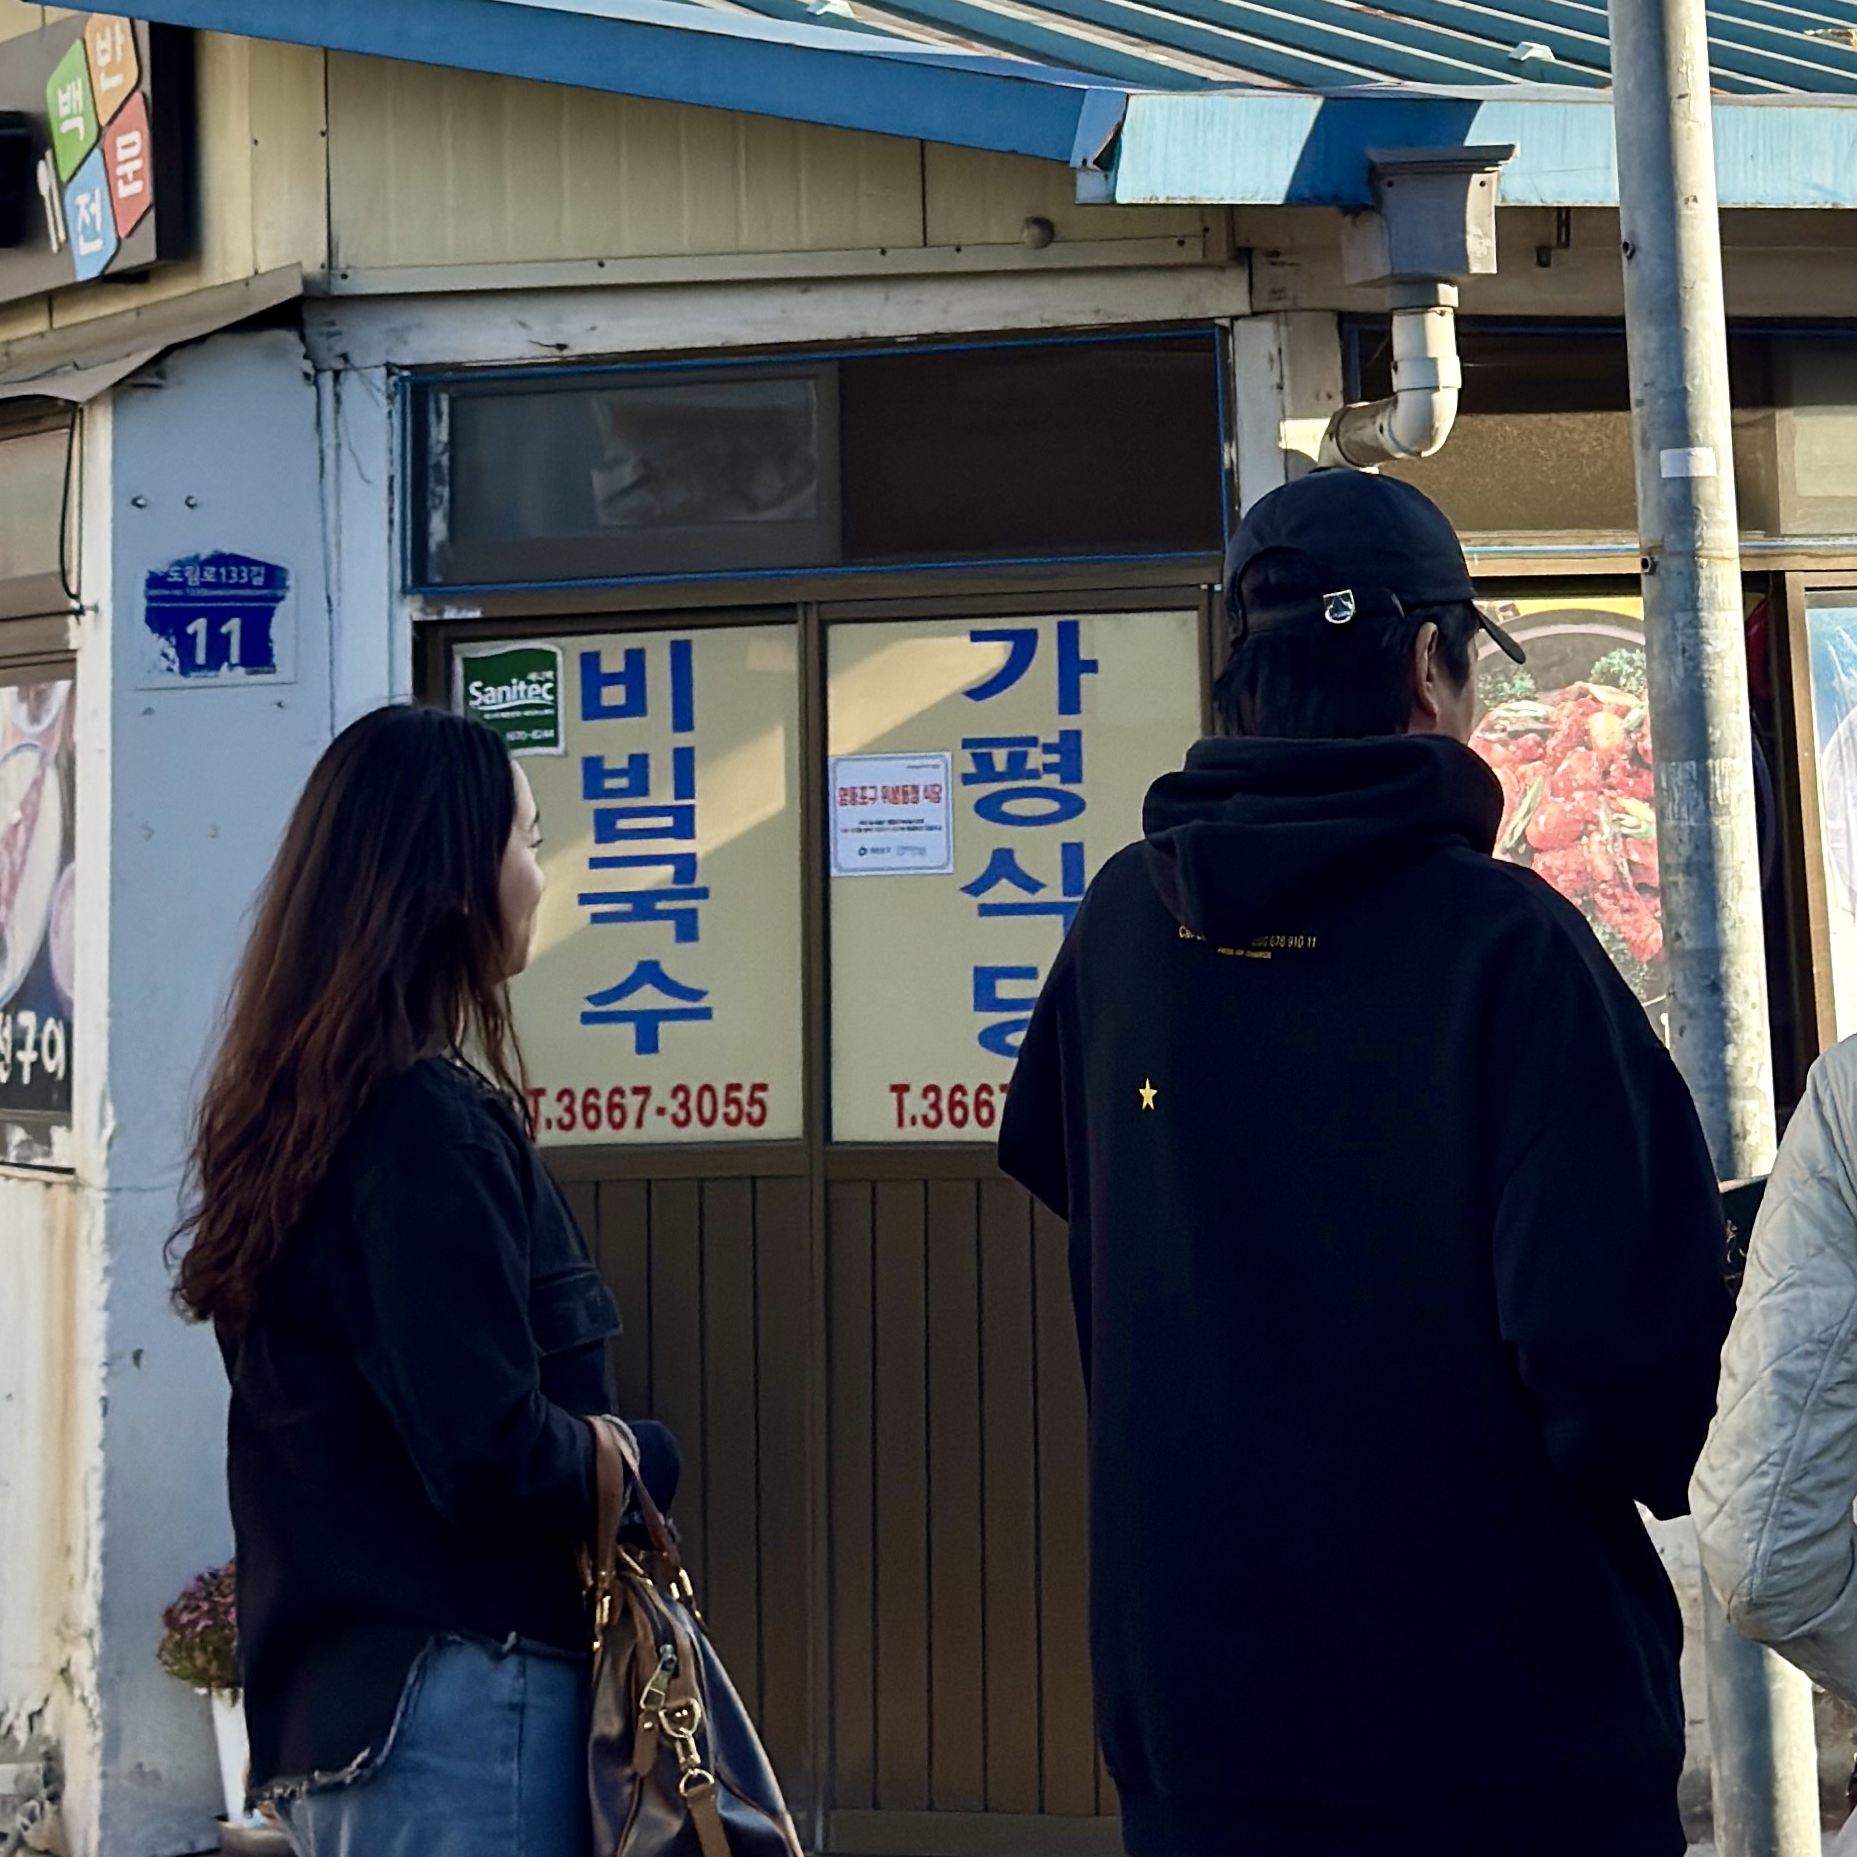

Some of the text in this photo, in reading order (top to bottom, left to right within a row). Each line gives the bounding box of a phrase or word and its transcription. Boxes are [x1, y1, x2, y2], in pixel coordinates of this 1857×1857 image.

[186, 617, 241, 665] 11
[468, 678, 554, 709] Sanitec
[578, 638, 713, 1056] 비빔국수
[527, 1083, 769, 1132] T.3667-3055
[889, 1083, 1009, 1129] T.366
